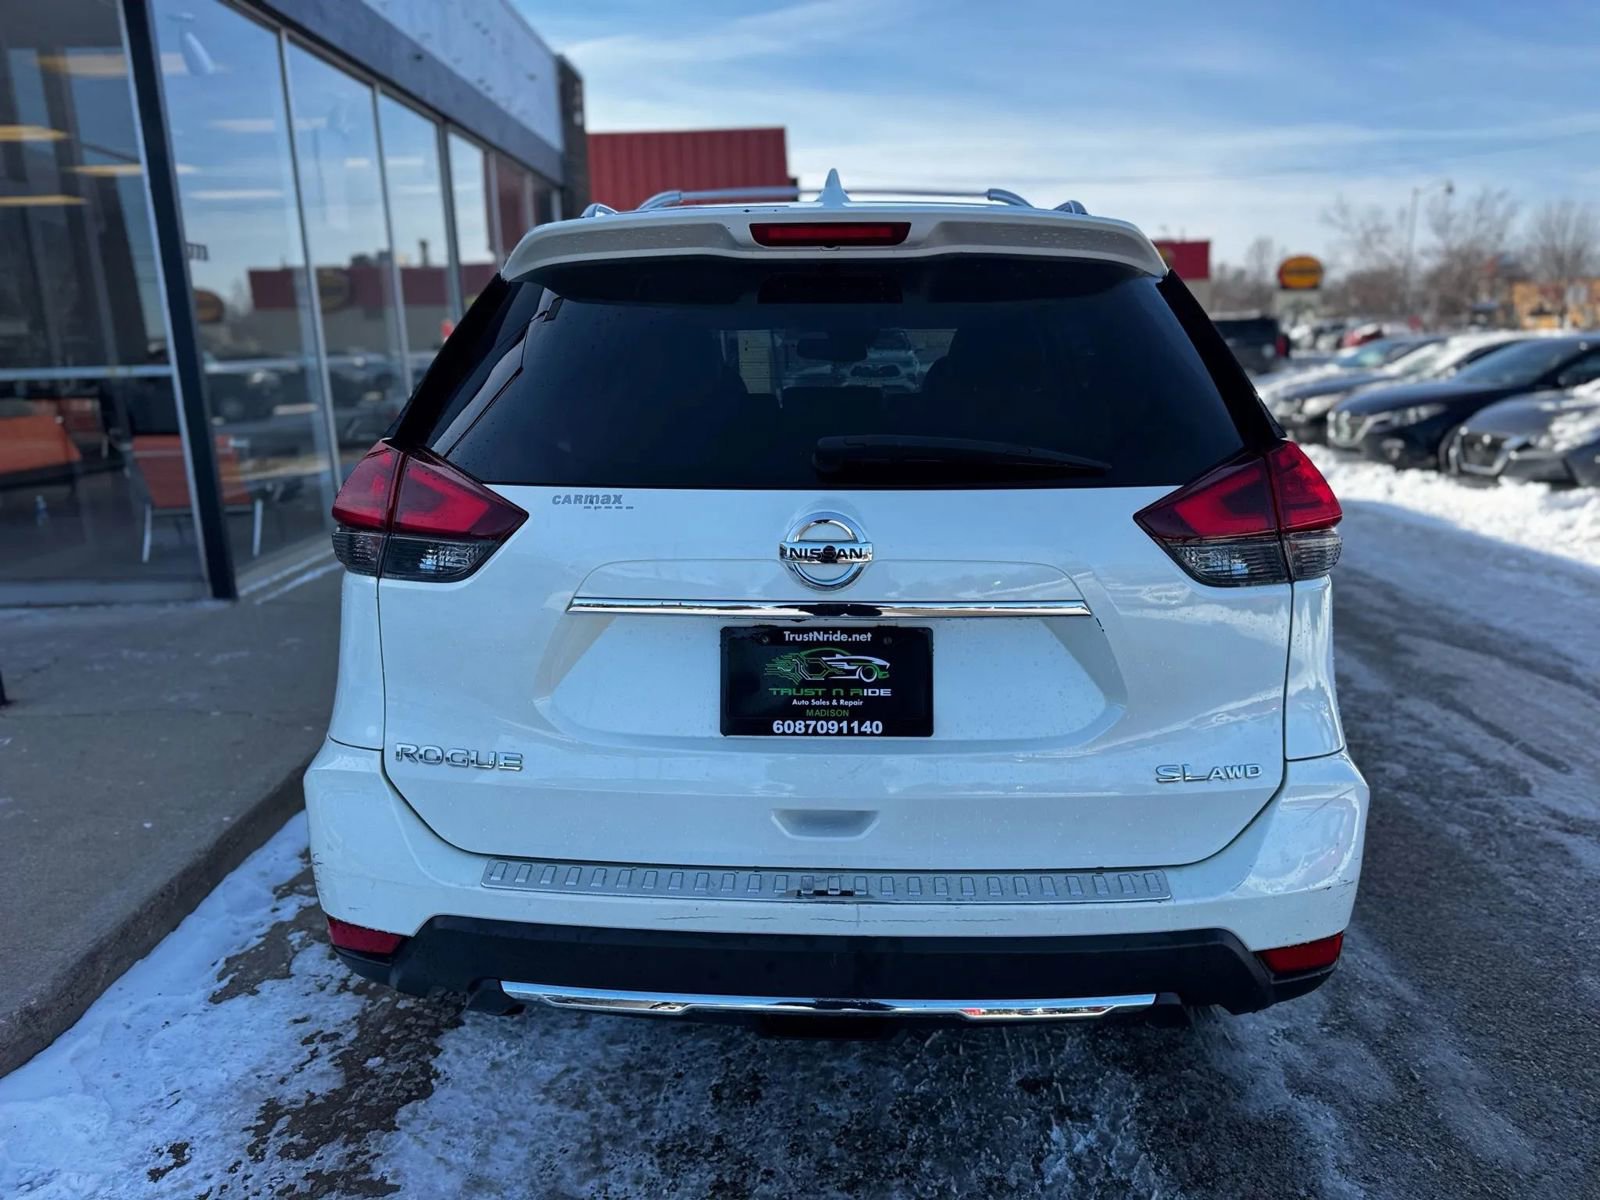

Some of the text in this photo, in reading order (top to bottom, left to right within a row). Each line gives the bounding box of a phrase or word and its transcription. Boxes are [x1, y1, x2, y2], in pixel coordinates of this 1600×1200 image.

[789, 547, 863, 560] NISSAN
[783, 630, 873, 643] TrustNride.net
[768, 687, 827, 697] TRUST
[850, 688, 892, 697] RIDE
[839, 699, 864, 708] Repair
[806, 709, 850, 718] MADISON
[772, 720, 884, 735] 6087091140
[395, 742, 524, 772] ROGUE
[1155, 763, 1264, 784] SL AWD
